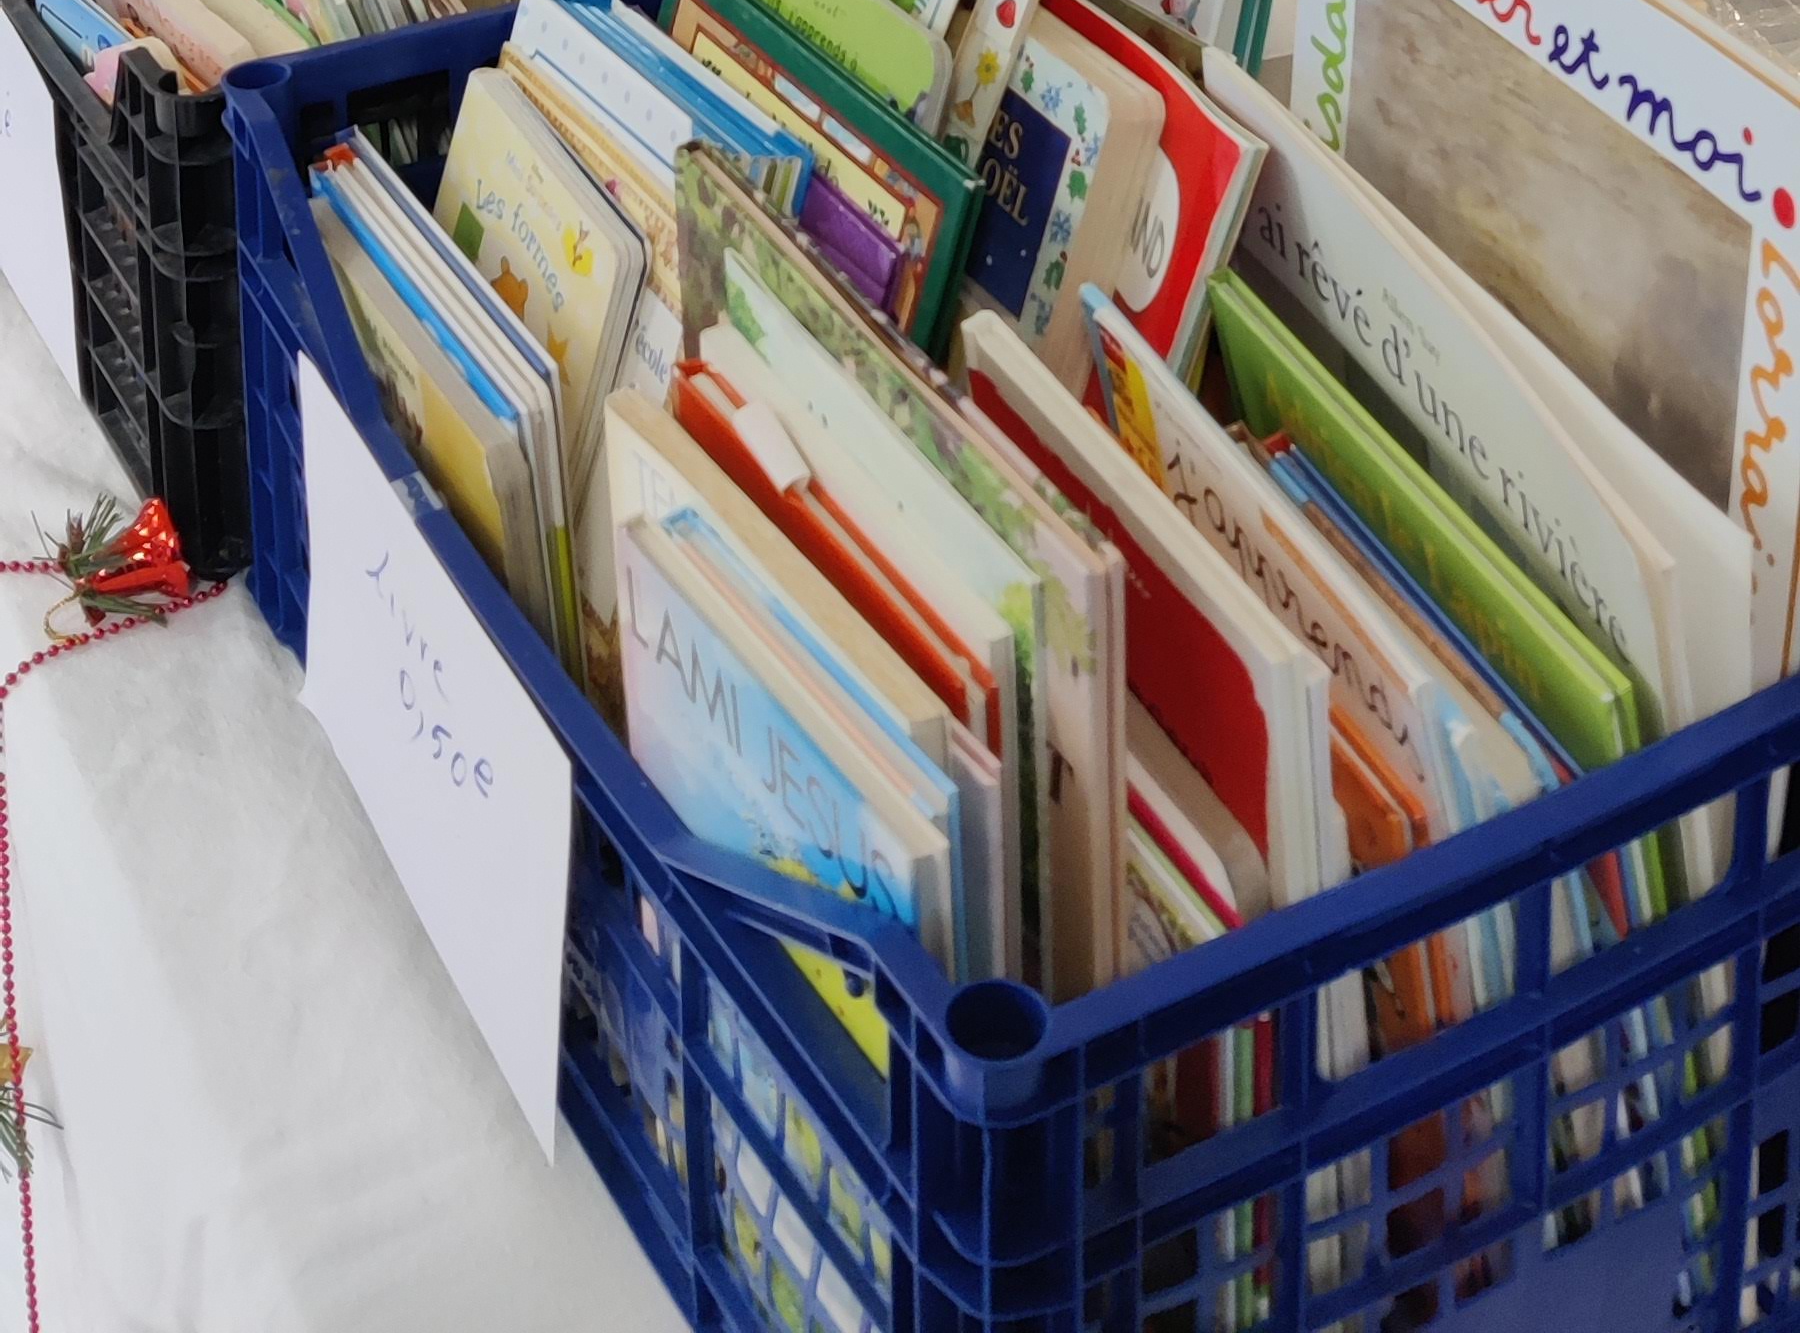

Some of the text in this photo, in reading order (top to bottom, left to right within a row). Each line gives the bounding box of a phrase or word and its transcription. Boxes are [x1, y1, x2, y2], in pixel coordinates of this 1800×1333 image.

[1549, 24, 1610, 89] et
[1618, 75, 1762, 204] moi
[475, 178, 506, 221] Les
[510, 202, 565, 313] formes
[1297, 238, 1375, 348] rêvé
[1381, 324, 1491, 481] d'une
[1498, 469, 1635, 665] rivière
